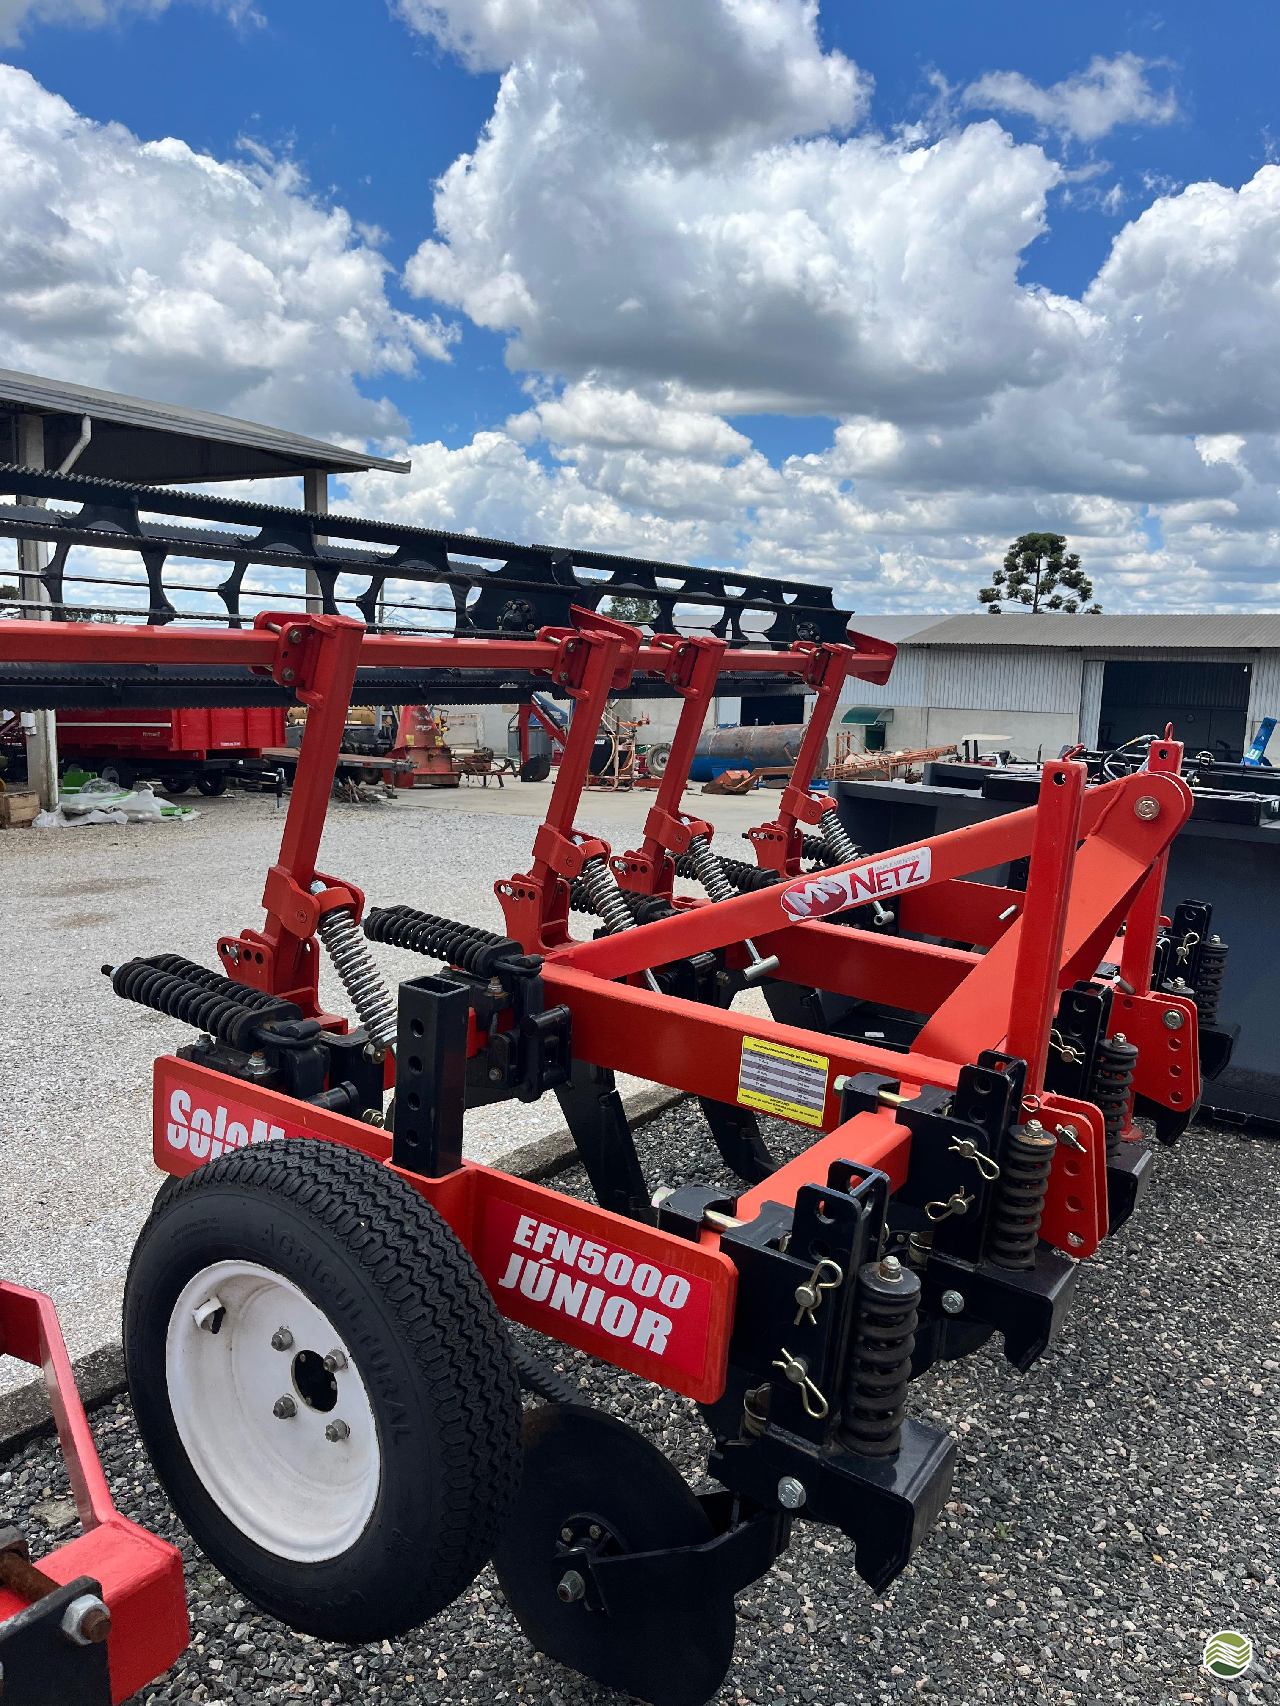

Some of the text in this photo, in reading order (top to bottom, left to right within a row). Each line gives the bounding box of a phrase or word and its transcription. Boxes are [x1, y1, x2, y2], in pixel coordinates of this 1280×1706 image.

[849, 861, 925, 900] NETZ
[874, 855, 920, 872] IMPLEMENTOS
[497, 1253, 673, 1356] JÚNIOR
[512, 1214, 692, 1310] EFN5000
[261, 1221, 412, 1446] AGRICULTURAL
